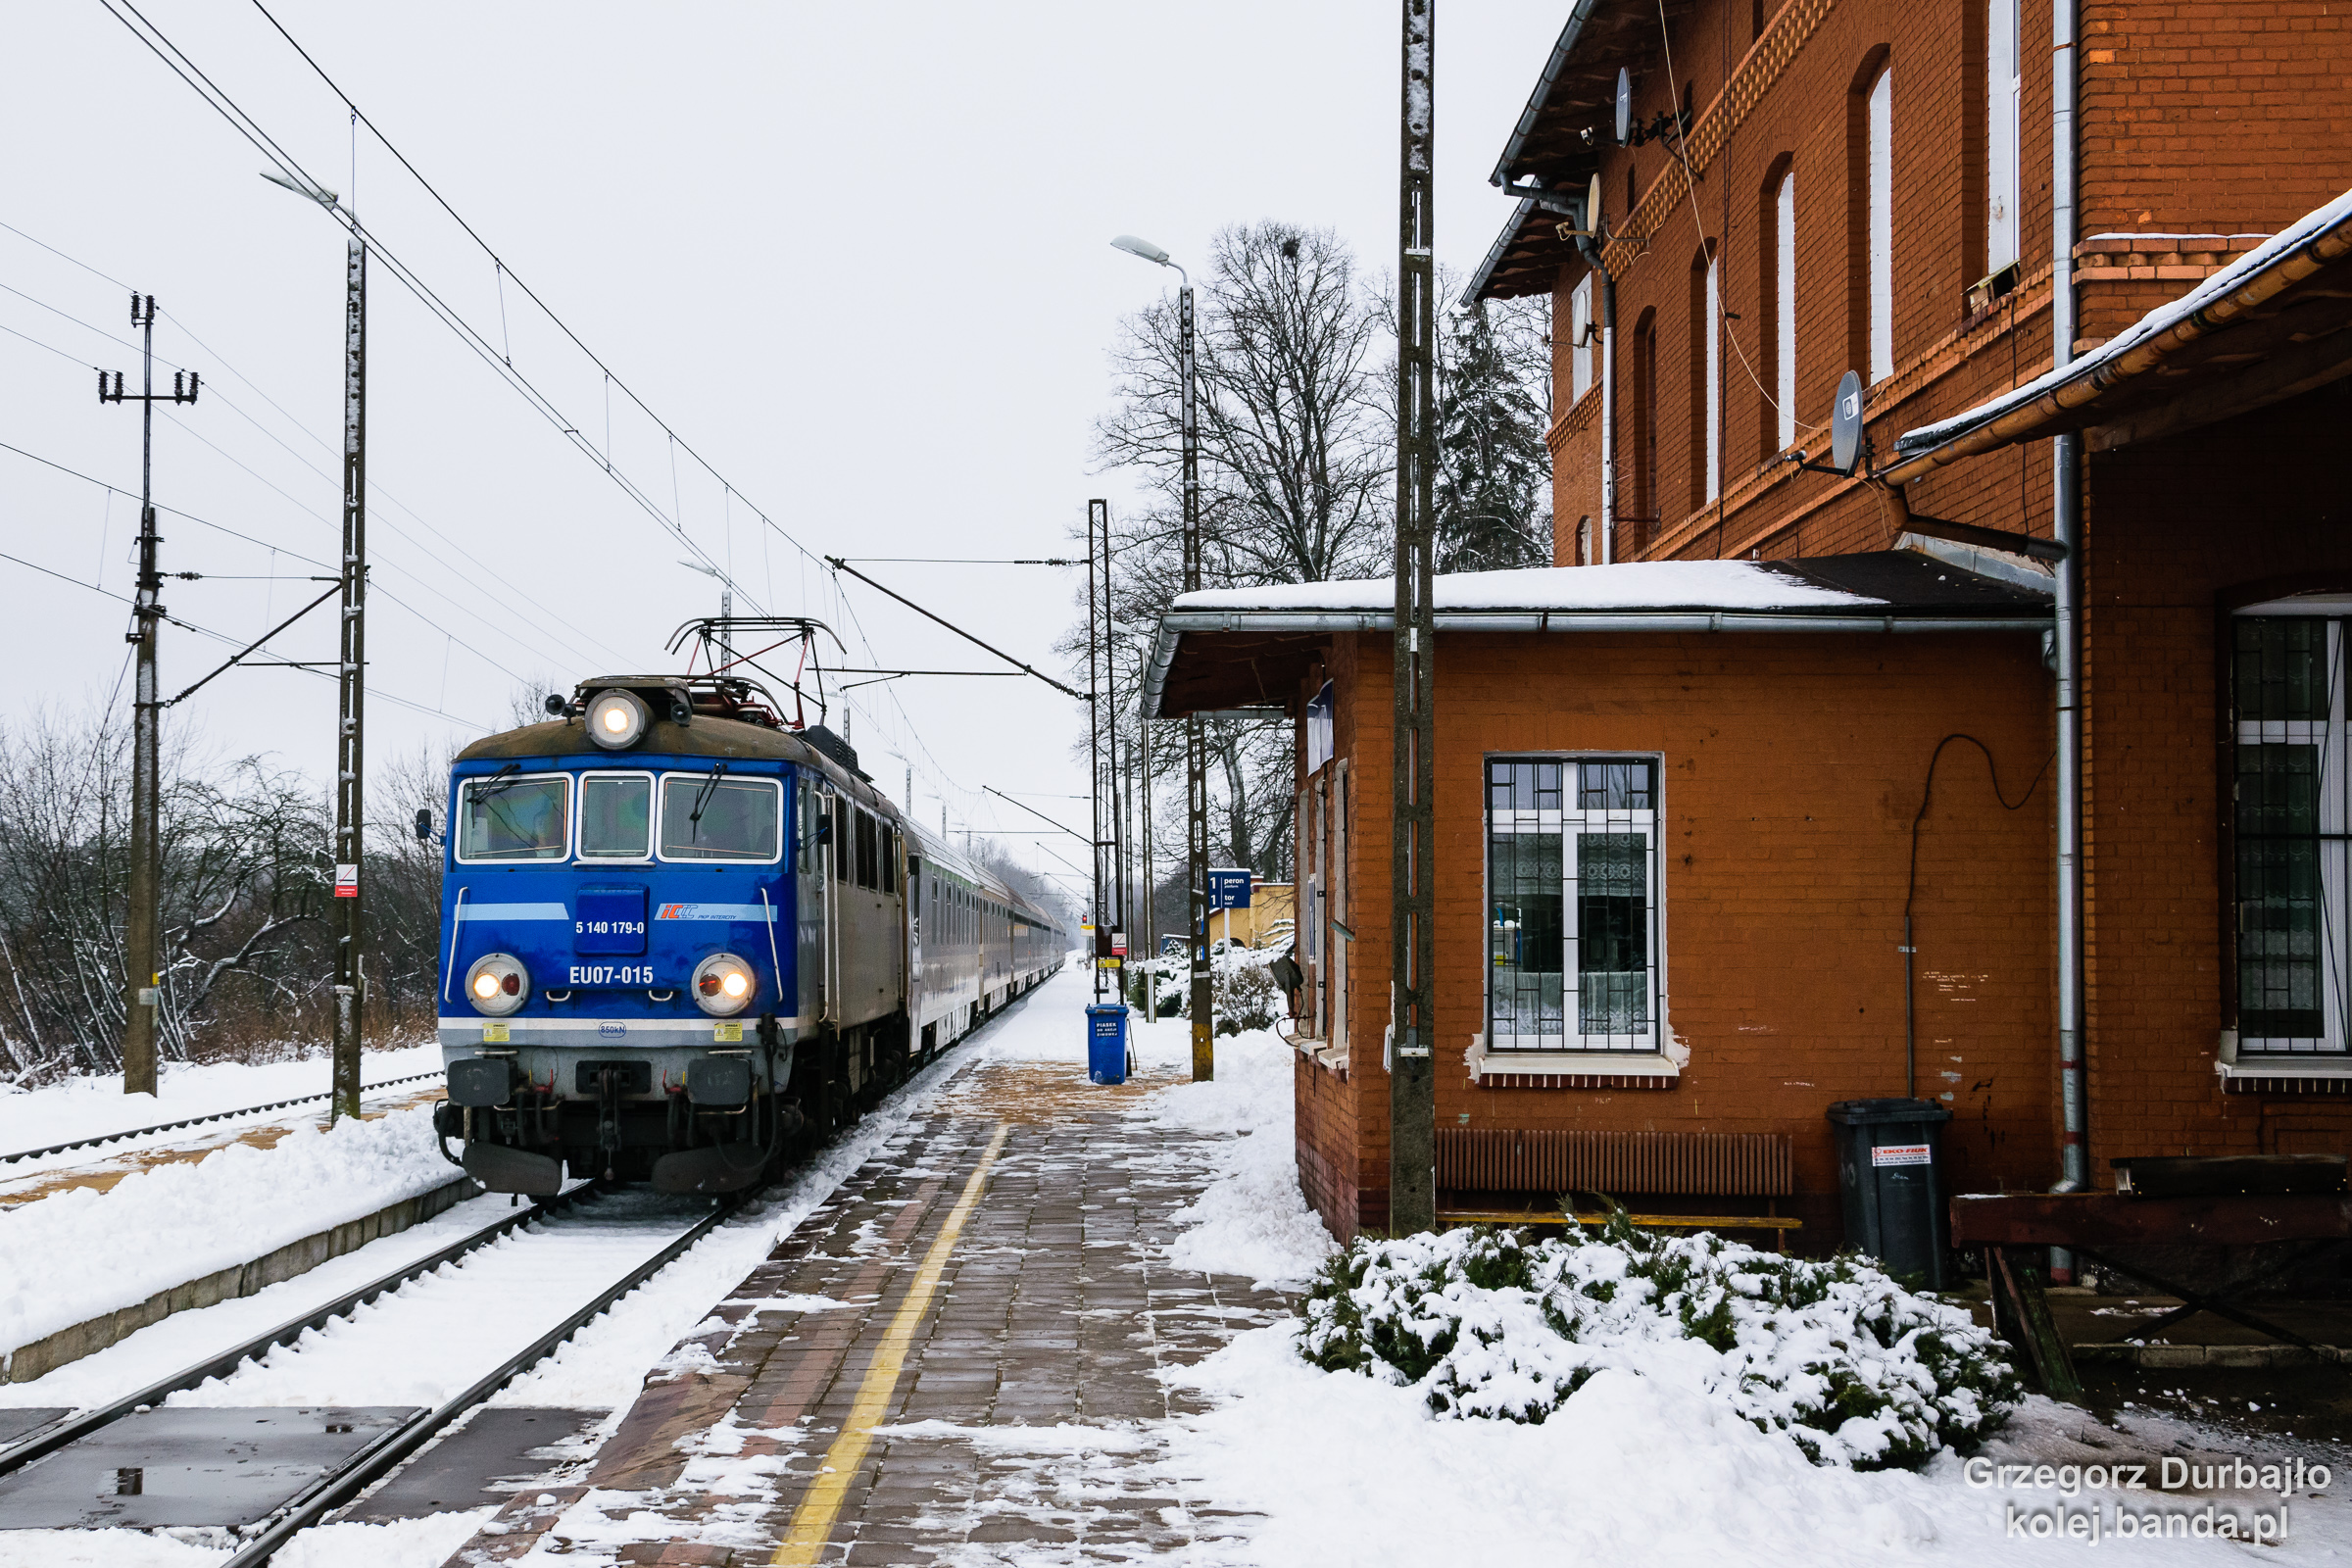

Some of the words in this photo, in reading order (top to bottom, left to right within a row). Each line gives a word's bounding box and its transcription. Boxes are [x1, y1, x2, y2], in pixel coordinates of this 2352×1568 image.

[1210, 877, 1216, 889] 1
[1210, 895, 1216, 906] 1
[575, 921, 584, 934] 5
[586, 921, 609, 934] 140
[611, 921, 645, 934] 179-0
[569, 965, 654, 984] EU07-015
